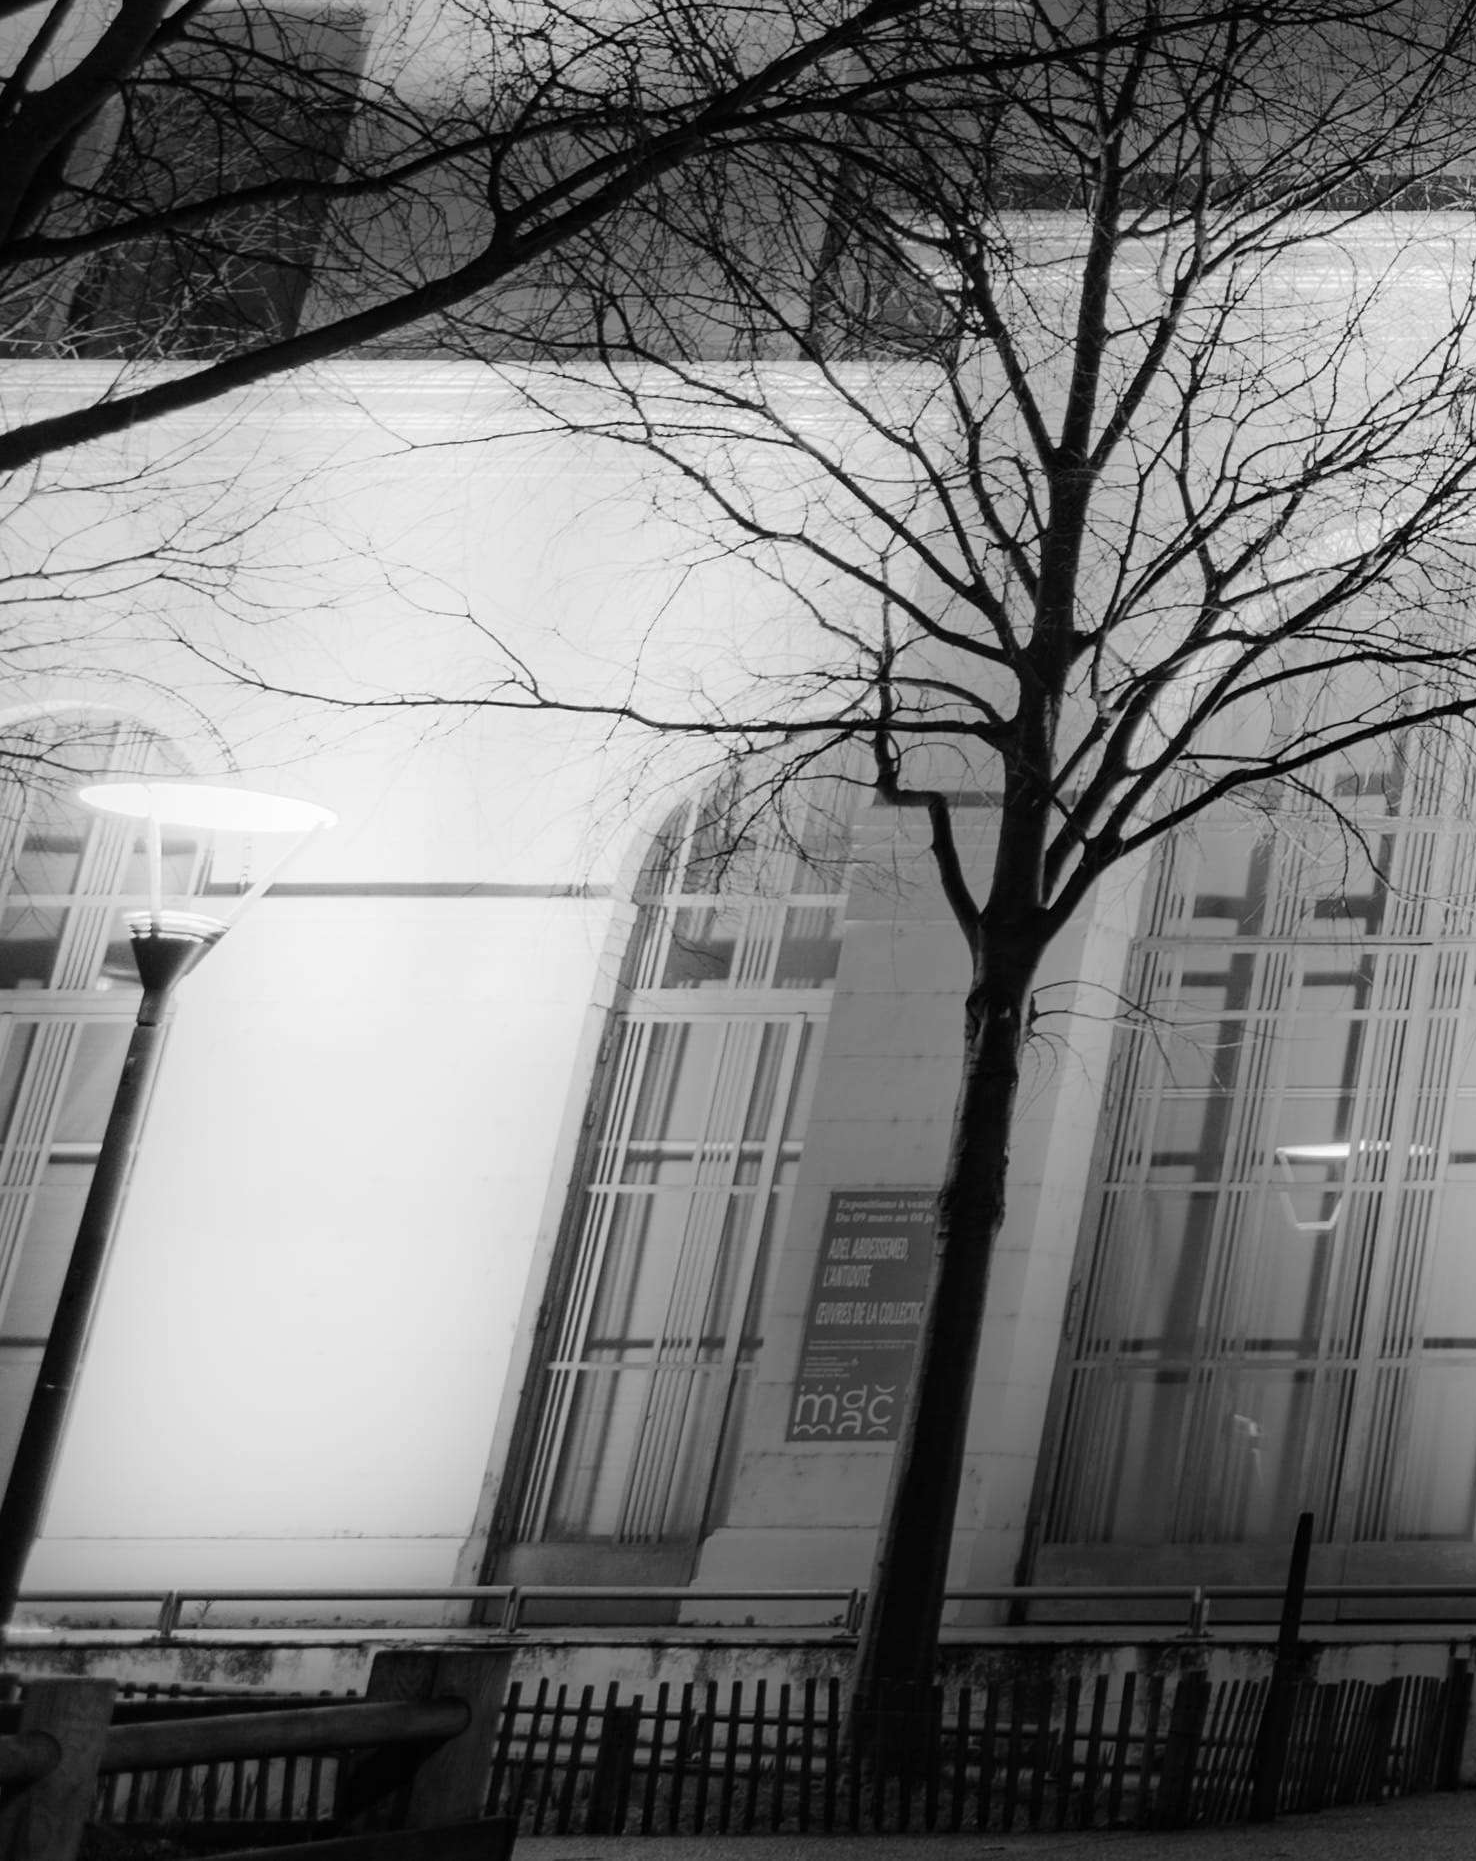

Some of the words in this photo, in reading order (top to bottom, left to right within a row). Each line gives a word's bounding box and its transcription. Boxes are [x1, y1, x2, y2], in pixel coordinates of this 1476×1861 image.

[838, 1198, 897, 1211] Expositions
[834, 1212, 850, 1223] Du
[852, 1212, 867, 1223] 09
[867, 1214, 893, 1223] mars
[895, 1214, 908, 1223] au
[827, 1237, 851, 1260] ADEL
[853, 1301, 867, 1326] DE
[865, 1301, 879, 1326] LA
